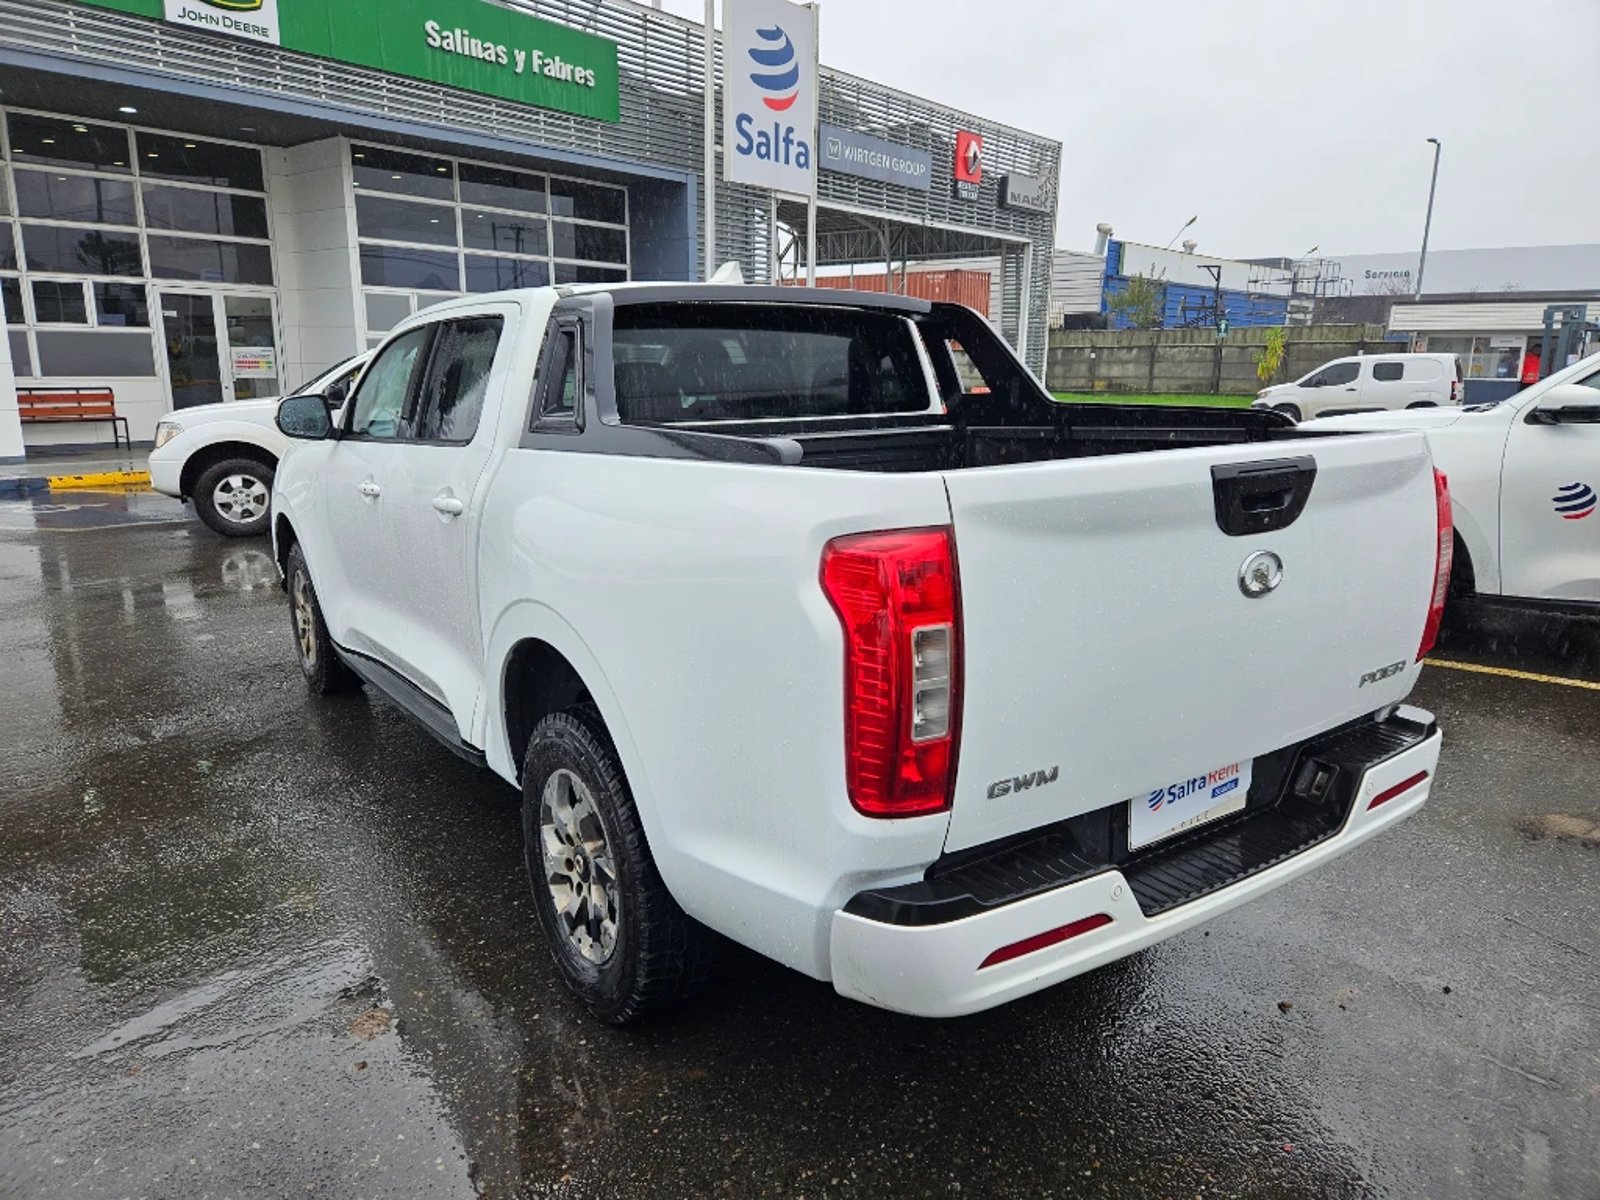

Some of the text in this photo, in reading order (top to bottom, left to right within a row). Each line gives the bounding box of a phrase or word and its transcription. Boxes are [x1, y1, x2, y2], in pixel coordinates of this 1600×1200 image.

[178, 7, 270, 38] JOHN DEERE
[424, 19, 596, 87] Salinas y Fabres
[735, 112, 810, 170] Salfa
[843, 144, 926, 176] WIRTGEN GROUP
[1010, 191, 1048, 208] MACK
[1364, 269, 1410, 279] Servicio
[1358, 659, 1407, 688] POER
[986, 765, 1059, 800] GWM
